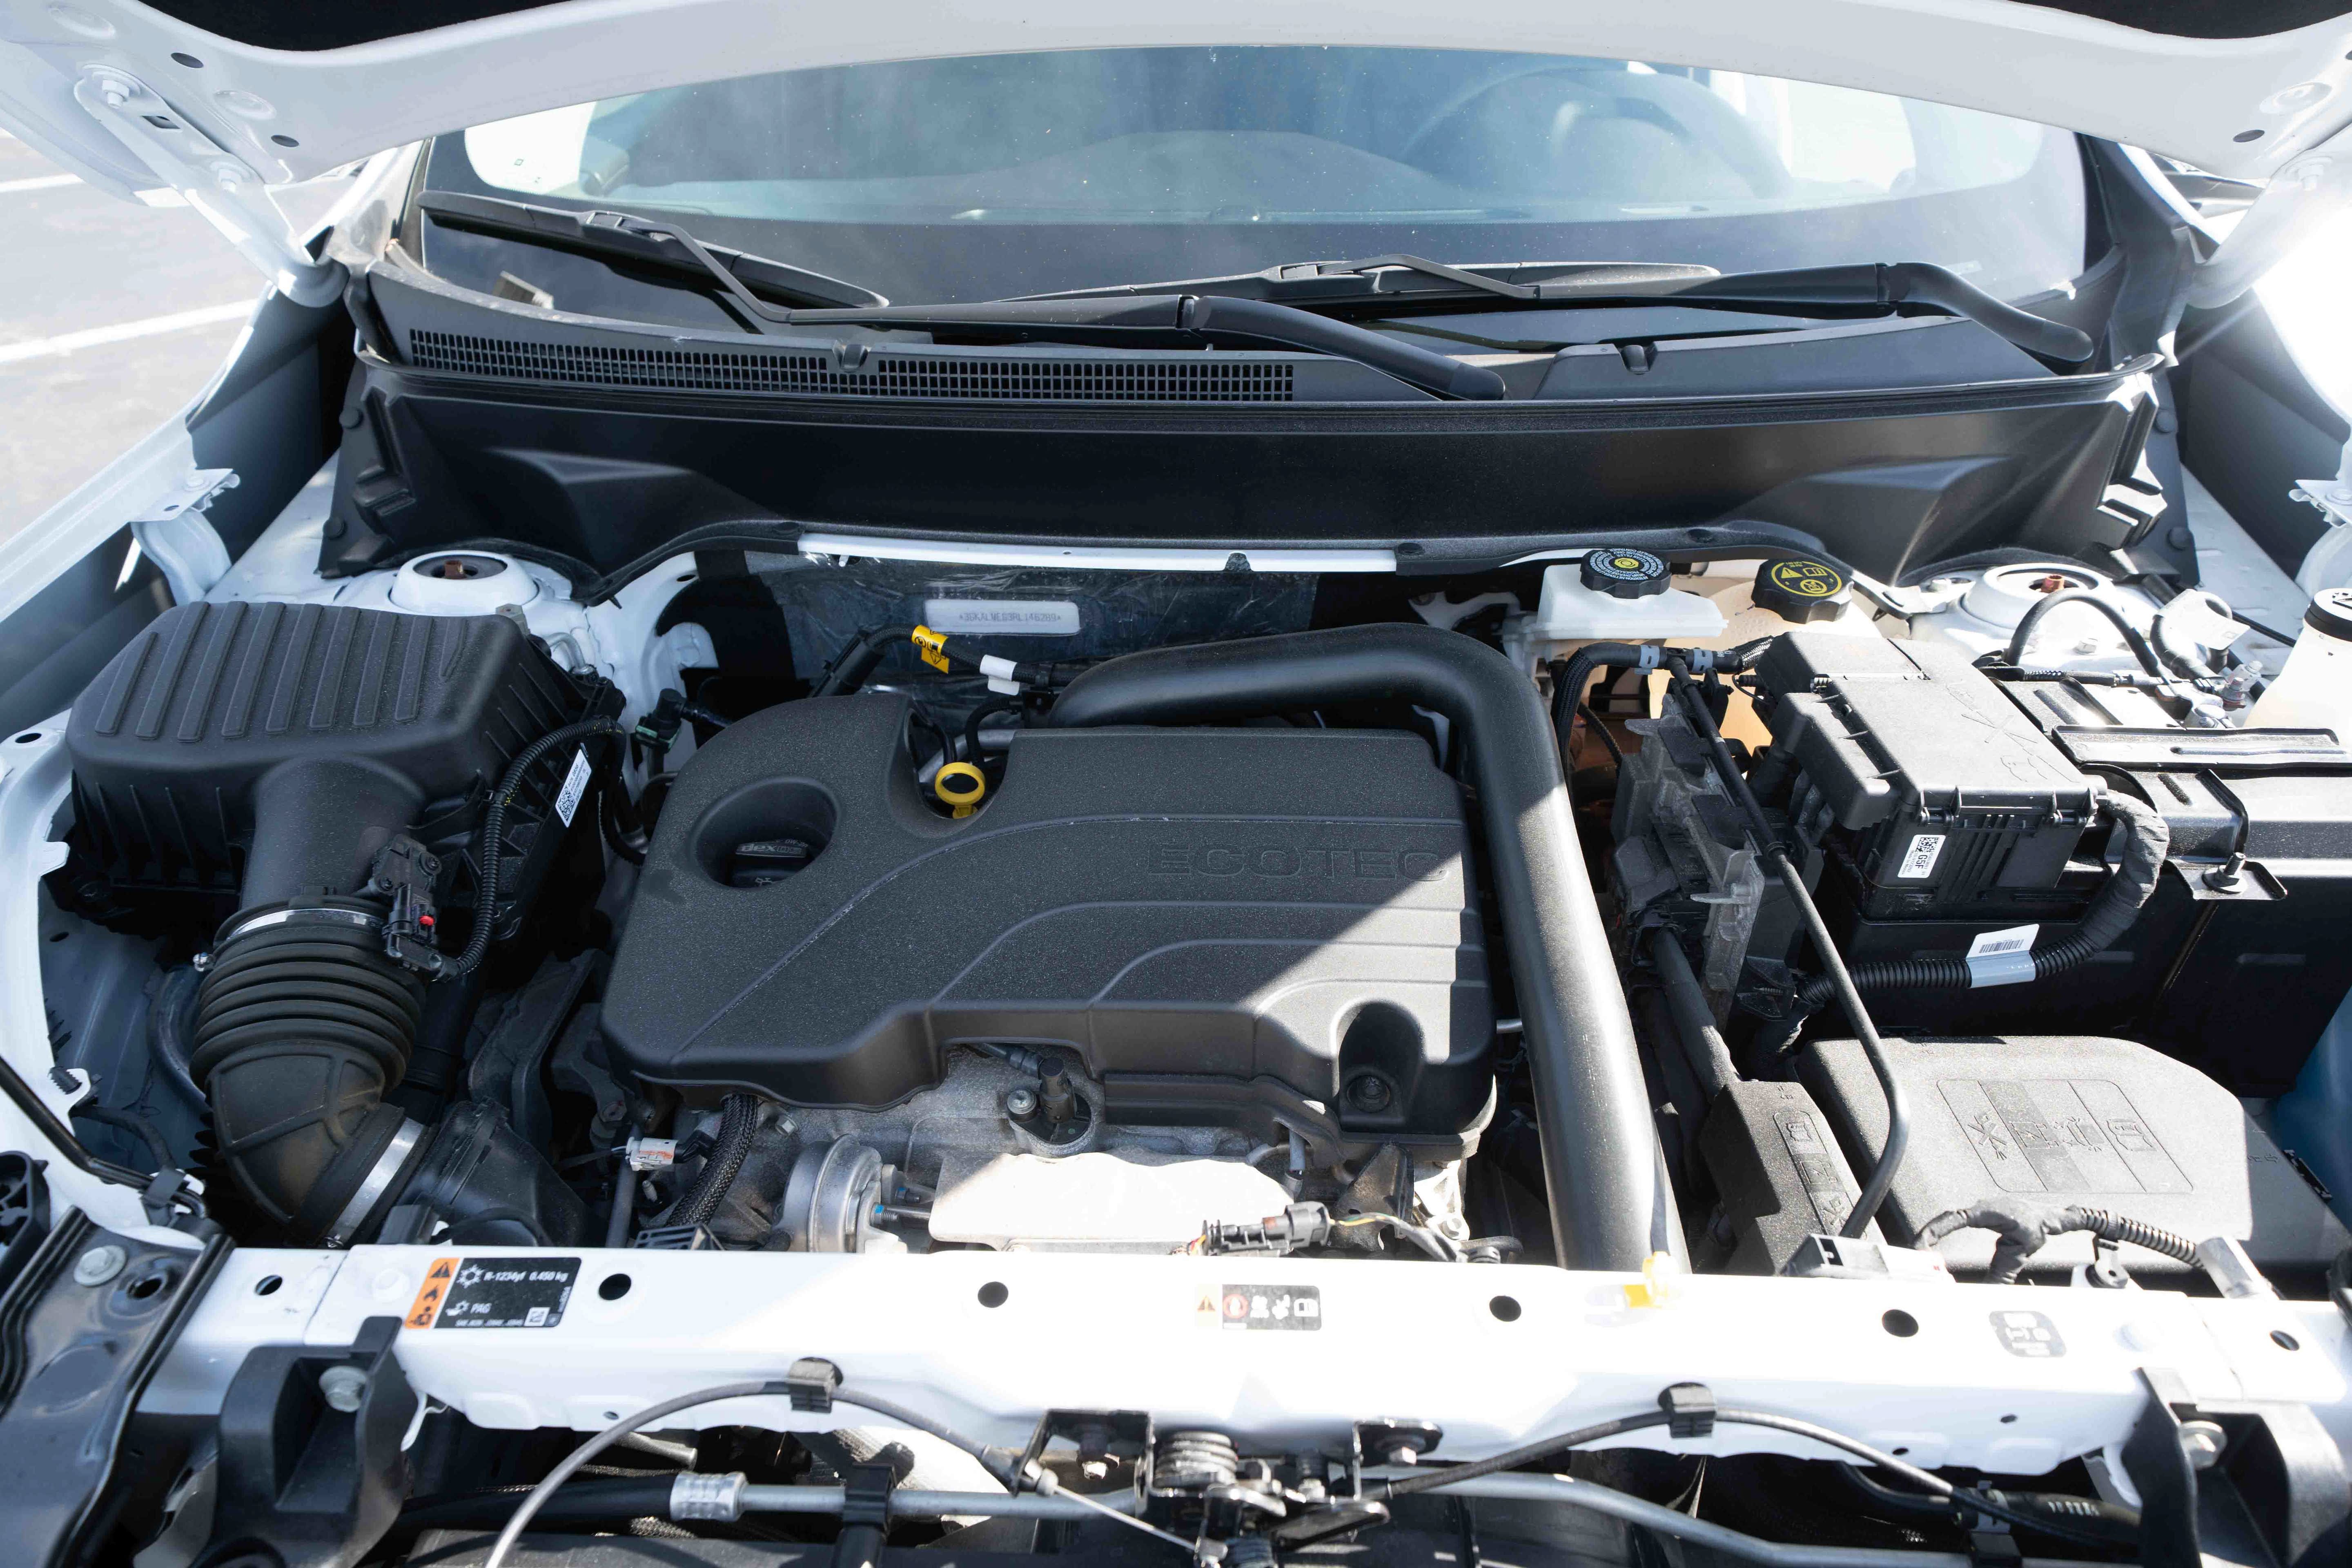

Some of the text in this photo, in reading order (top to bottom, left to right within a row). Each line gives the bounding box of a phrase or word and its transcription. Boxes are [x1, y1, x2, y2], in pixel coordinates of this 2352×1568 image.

[1147, 846, 1449, 882] ECOTEC
[1915, 855, 1928, 869] G5F
[555, 1271, 569, 1283] kg
[470, 1303, 492, 1314] PAG
